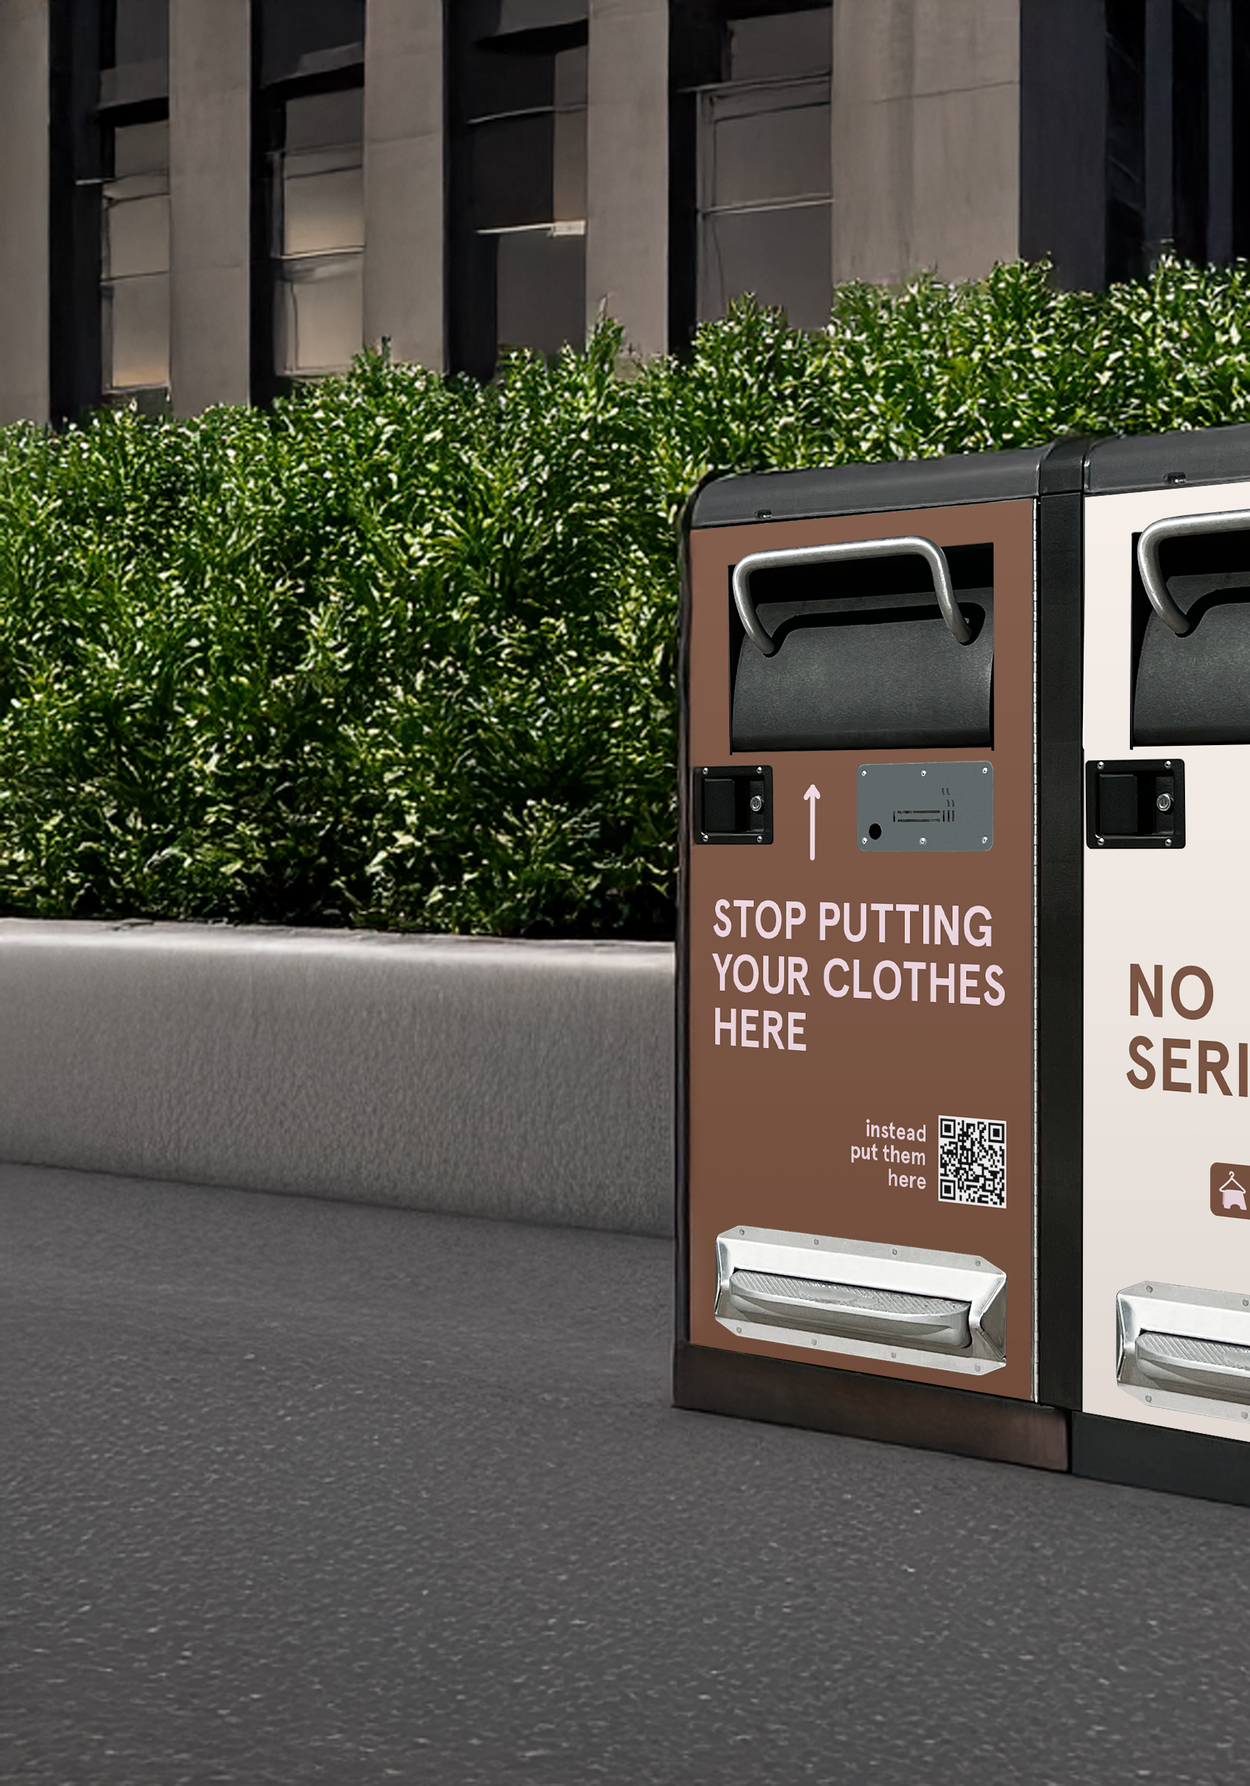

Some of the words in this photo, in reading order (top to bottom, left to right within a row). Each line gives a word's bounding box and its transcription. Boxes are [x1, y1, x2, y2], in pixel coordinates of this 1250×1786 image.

[713, 898, 806, 941] STOP
[819, 902, 993, 947] PUTTING
[712, 953, 811, 996] YOUR
[823, 958, 1006, 1007] CLOTHES
[1129, 963, 1214, 1020] NO
[714, 1008, 807, 1051] HERE
[866, 1119, 927, 1143] instead
[850, 1143, 878, 1164] put
[883, 1145, 926, 1166] them
[888, 1169, 927, 1189] here
